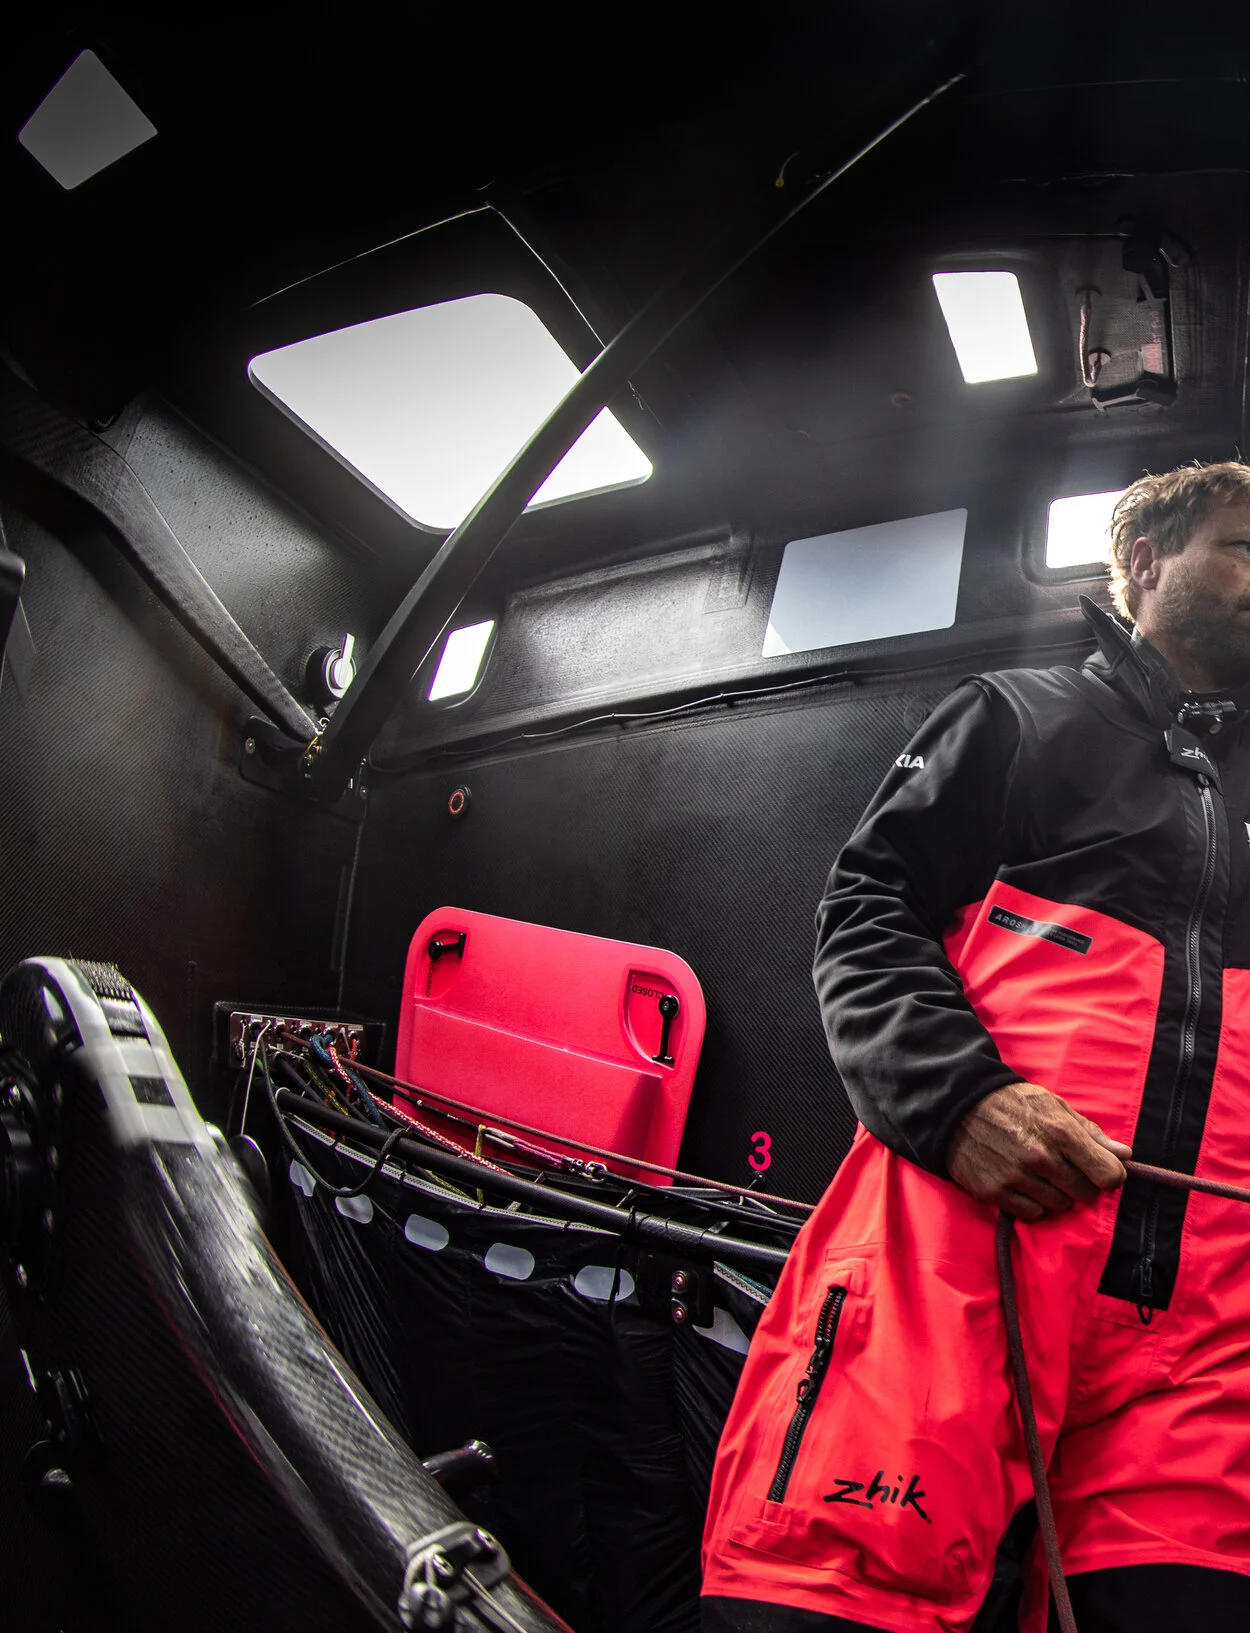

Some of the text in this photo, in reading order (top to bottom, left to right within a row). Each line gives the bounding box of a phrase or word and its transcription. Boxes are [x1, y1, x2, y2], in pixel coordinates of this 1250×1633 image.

[632, 984, 664, 1000] CLOSED
[748, 1131, 772, 1171] 3
[823, 1470, 929, 1522] zhik
